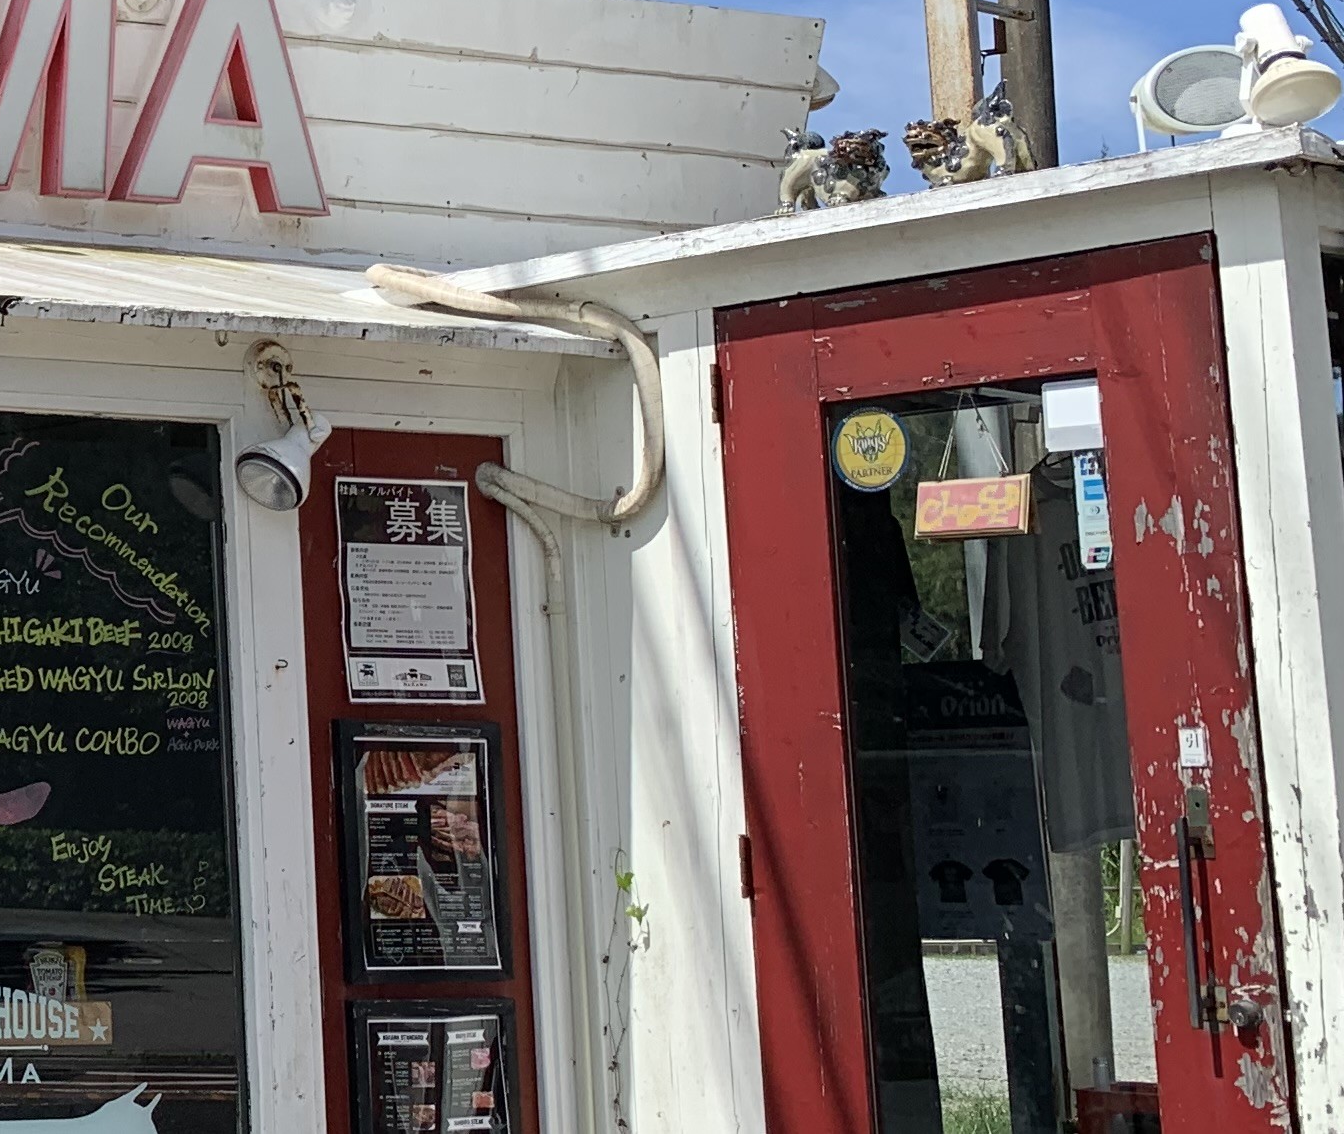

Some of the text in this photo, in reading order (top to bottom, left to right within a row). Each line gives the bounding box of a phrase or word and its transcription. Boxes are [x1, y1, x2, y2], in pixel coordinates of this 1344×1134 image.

[850, 466, 894, 479] PARTNER
[100, 483, 160, 537] Our
[383, 496, 464, 544] 募集
[23, 466, 214, 640] Recommendation
[85, 616, 143, 647] BEEF
[147, 631, 195, 653] 200g
[38, 665, 125, 693] WAGYU
[131, 662, 216, 692] SIRLOIN
[166, 690, 209, 710] 200g
[165, 715, 212, 730] WAGYU
[74, 725, 162, 756] COMBO
[50, 832, 113, 865] Enjoy
[97, 862, 170, 894] STEAK
